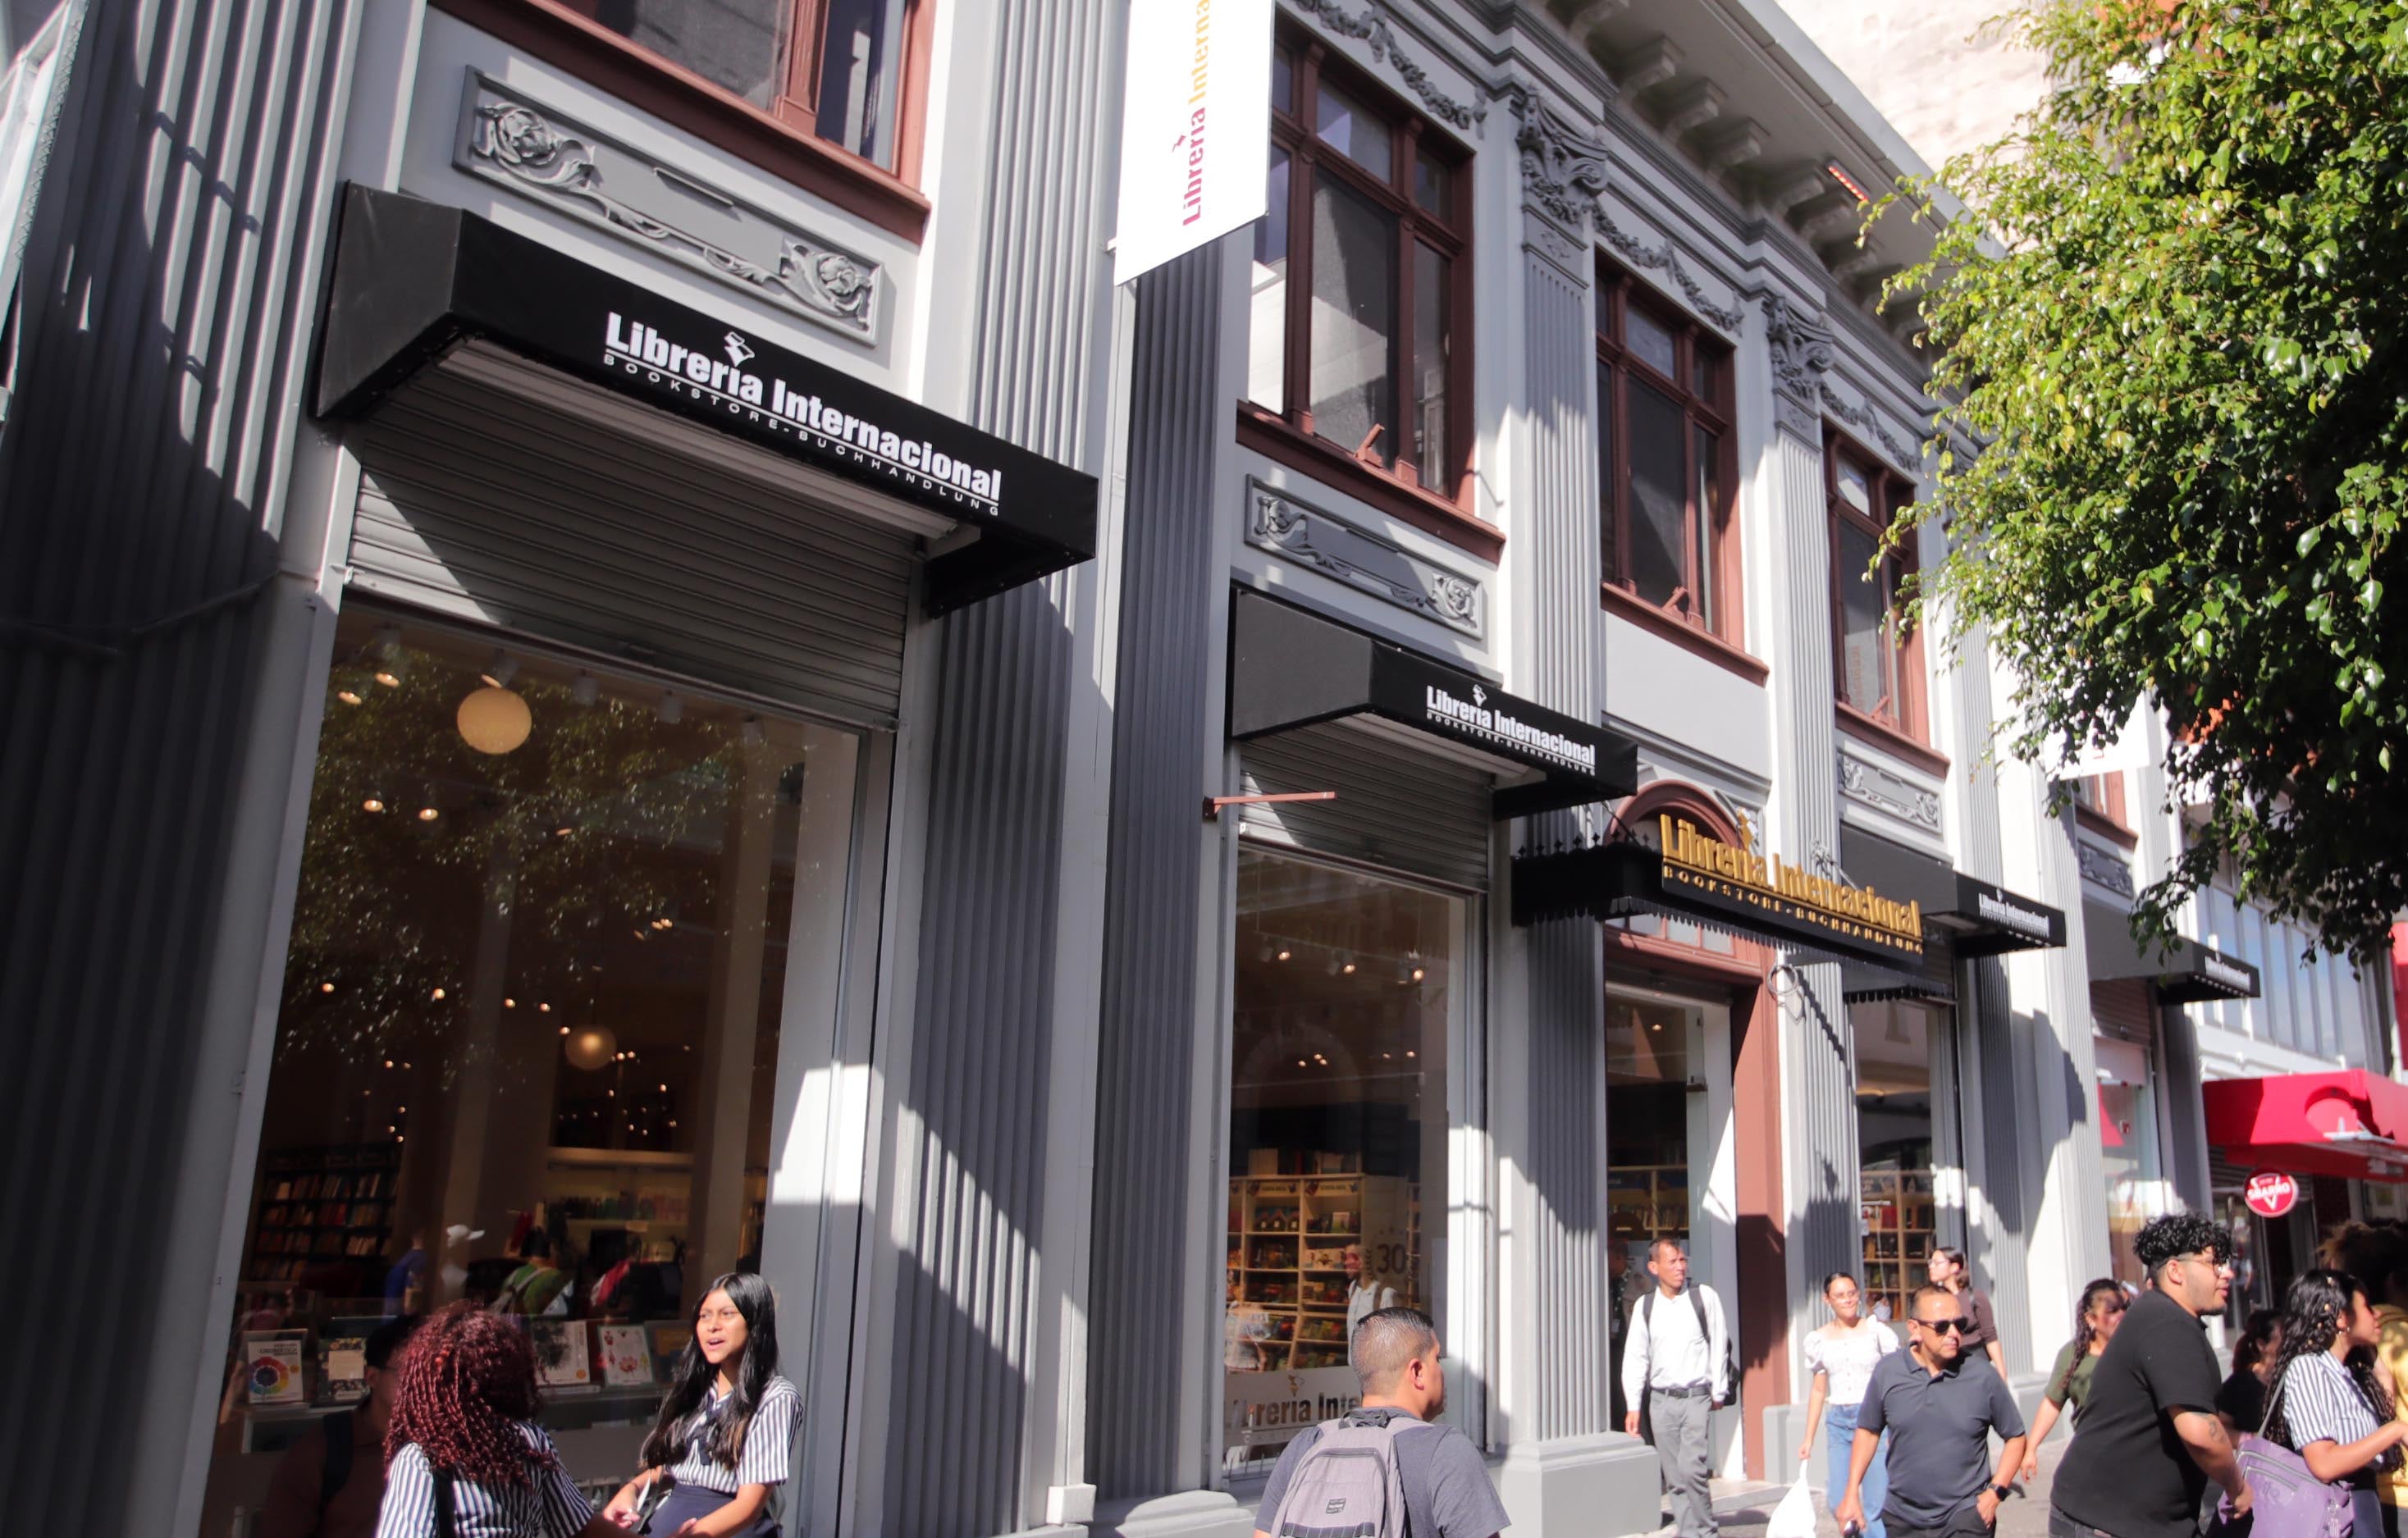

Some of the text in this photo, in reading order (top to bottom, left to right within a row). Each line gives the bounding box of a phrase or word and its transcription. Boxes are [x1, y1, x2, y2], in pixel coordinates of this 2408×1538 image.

[772, 379, 1002, 501] Internacional
[1494, 709, 1596, 766] Internacional
[1772, 852, 1922, 938] Internacional
[1376, 1243, 1406, 1274] 30
